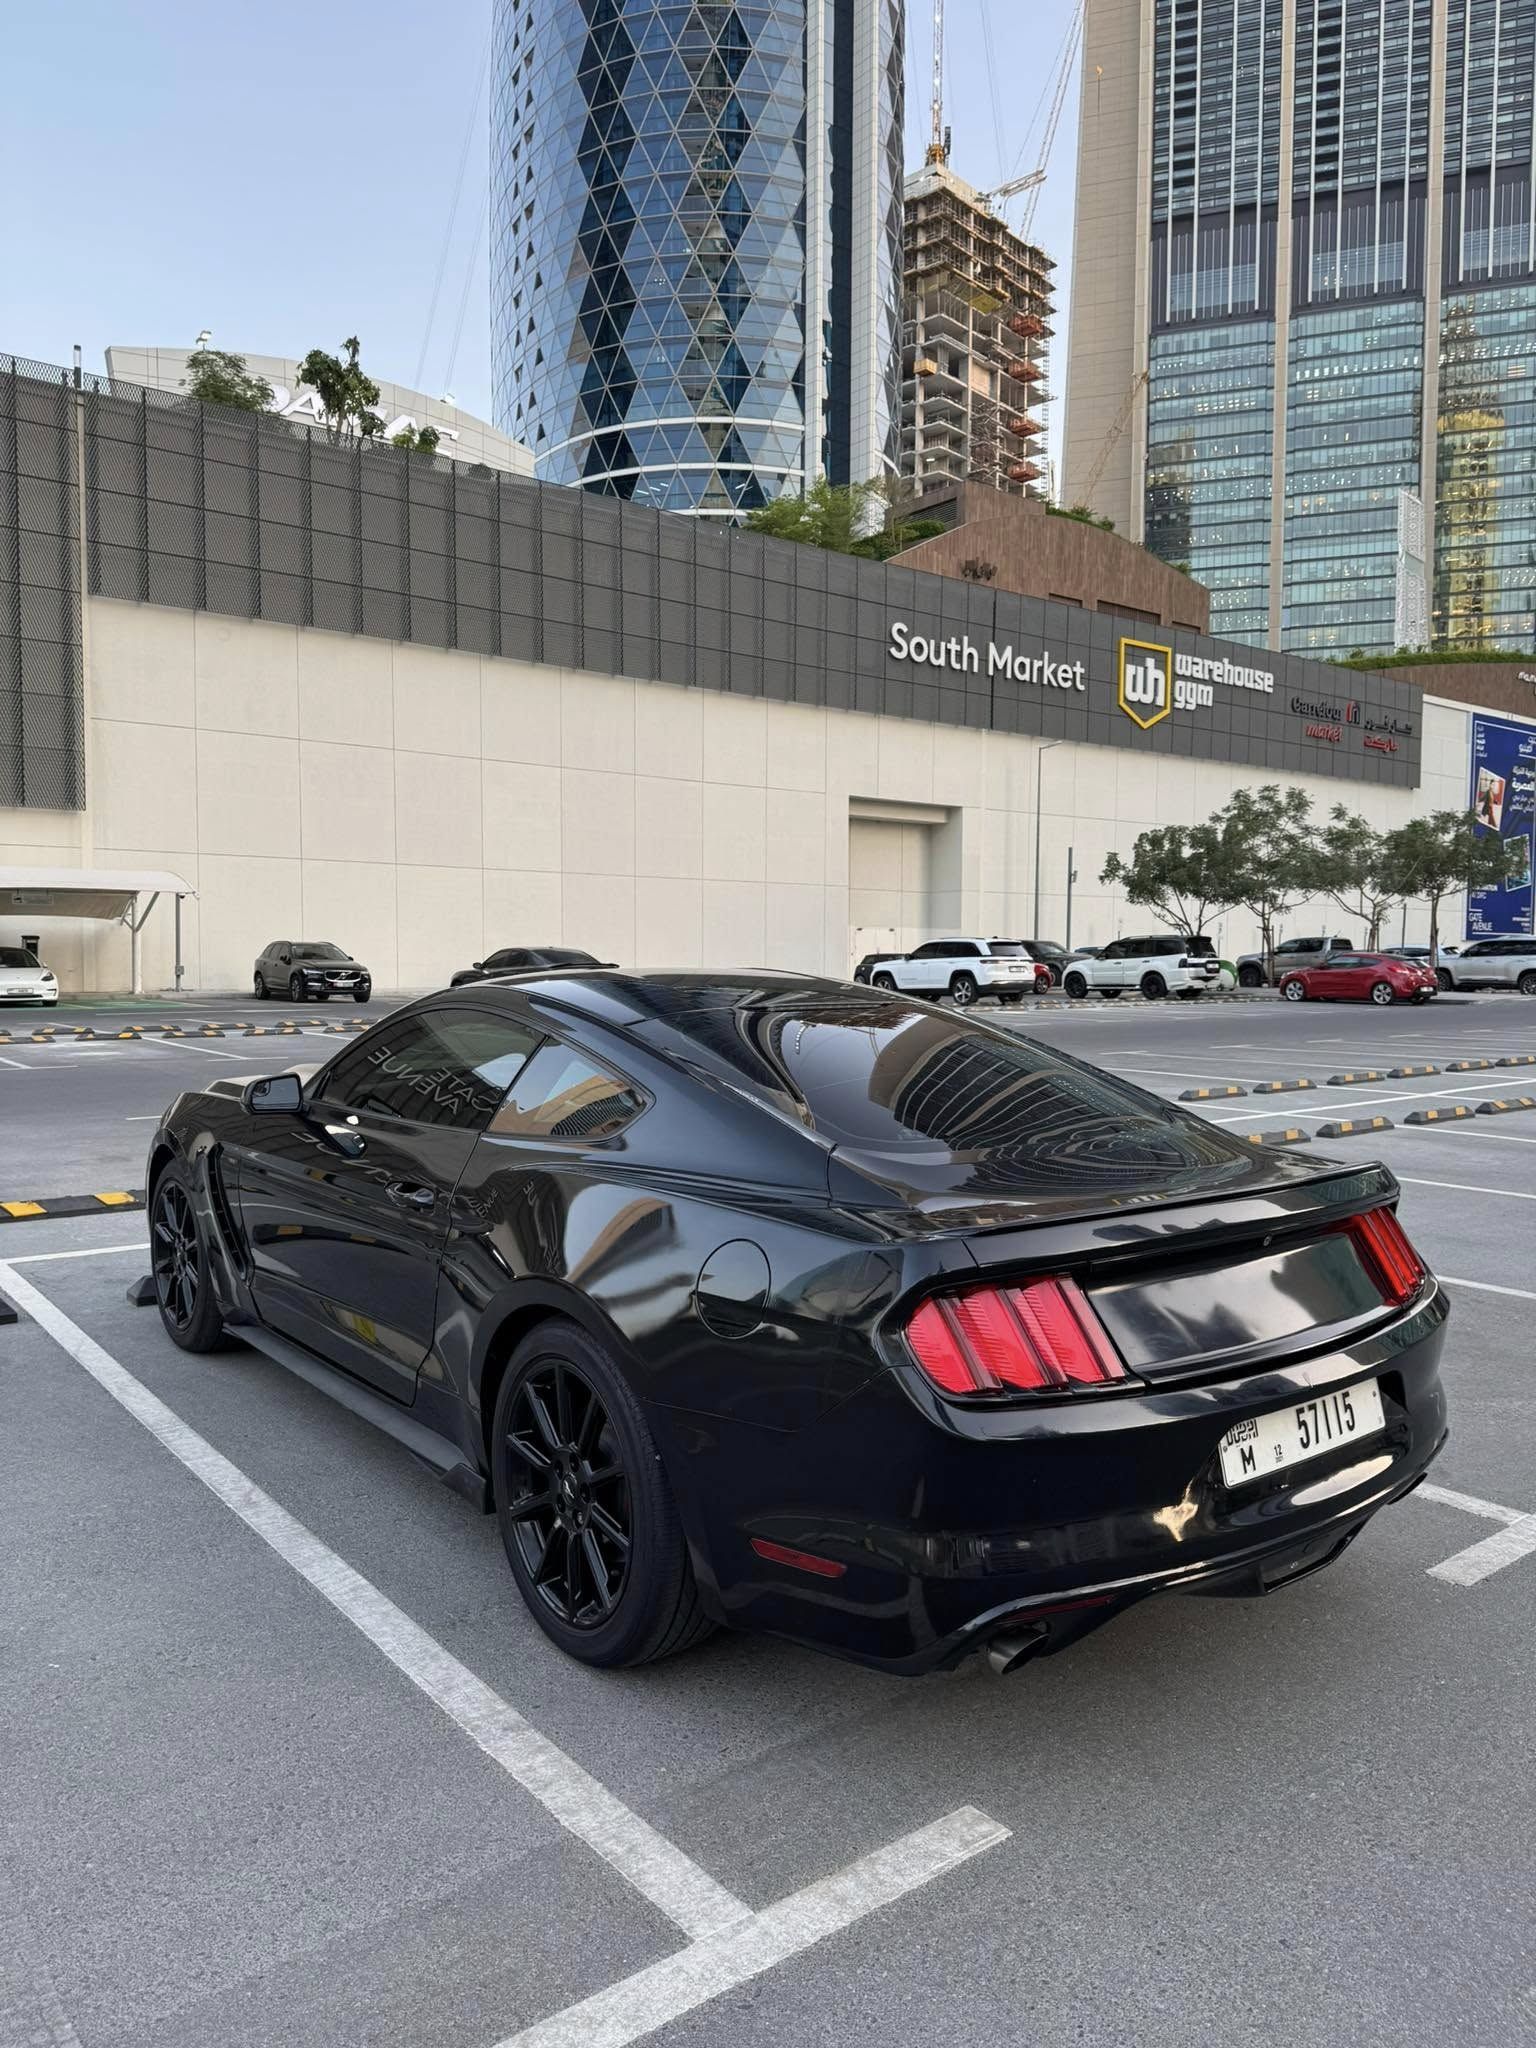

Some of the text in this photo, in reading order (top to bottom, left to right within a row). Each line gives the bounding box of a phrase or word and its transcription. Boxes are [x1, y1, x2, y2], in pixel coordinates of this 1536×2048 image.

[889, 622, 1086, 691] South Market
[1174, 653, 1274, 693] warehouse
[1125, 657, 1166, 707] wh
[1173, 680, 1214, 711] gym
[1305, 724, 1344, 744] market
[1295, 1391, 1356, 1450] 57115
[1240, 1444, 1282, 1474] M 12
